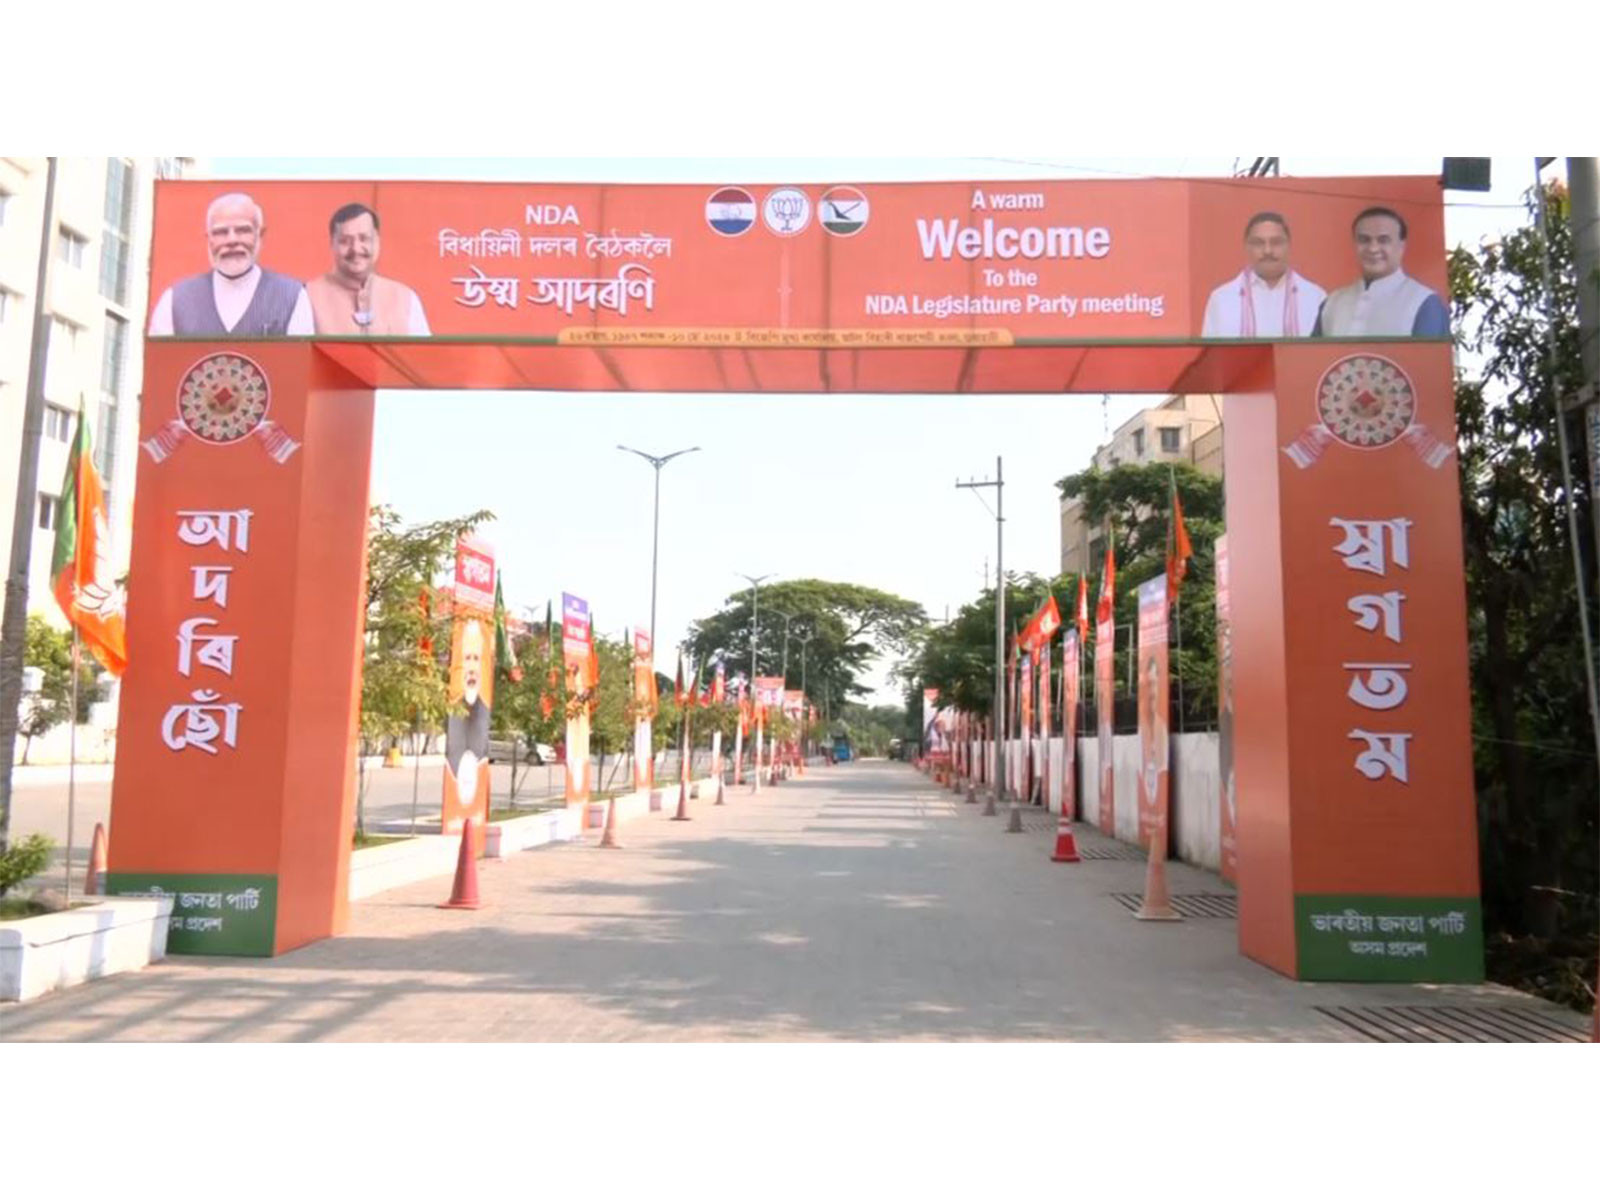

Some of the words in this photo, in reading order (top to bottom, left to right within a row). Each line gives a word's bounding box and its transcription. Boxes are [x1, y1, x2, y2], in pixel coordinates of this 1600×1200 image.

[970, 189, 987, 210] A
[989, 193, 1045, 210] warm
[525, 204, 580, 225] NDA
[438, 228, 522, 259] বিধায়িনী
[529, 235, 578, 258] দলৰ
[584, 229, 673, 259] বৈঠকলৈ
[915, 217, 1111, 259] Welcome
[982, 268, 1005, 288] To
[1007, 267, 1038, 287] the
[526, 263, 656, 316] আদৰণি
[864, 294, 909, 316] NDA
[911, 294, 1023, 319] Legislature
[1025, 293, 1079, 318] Party
[1081, 292, 1165, 318] meeting
[179, 892, 223, 910] জনতা
[1376, 914, 1425, 934] জনতা
